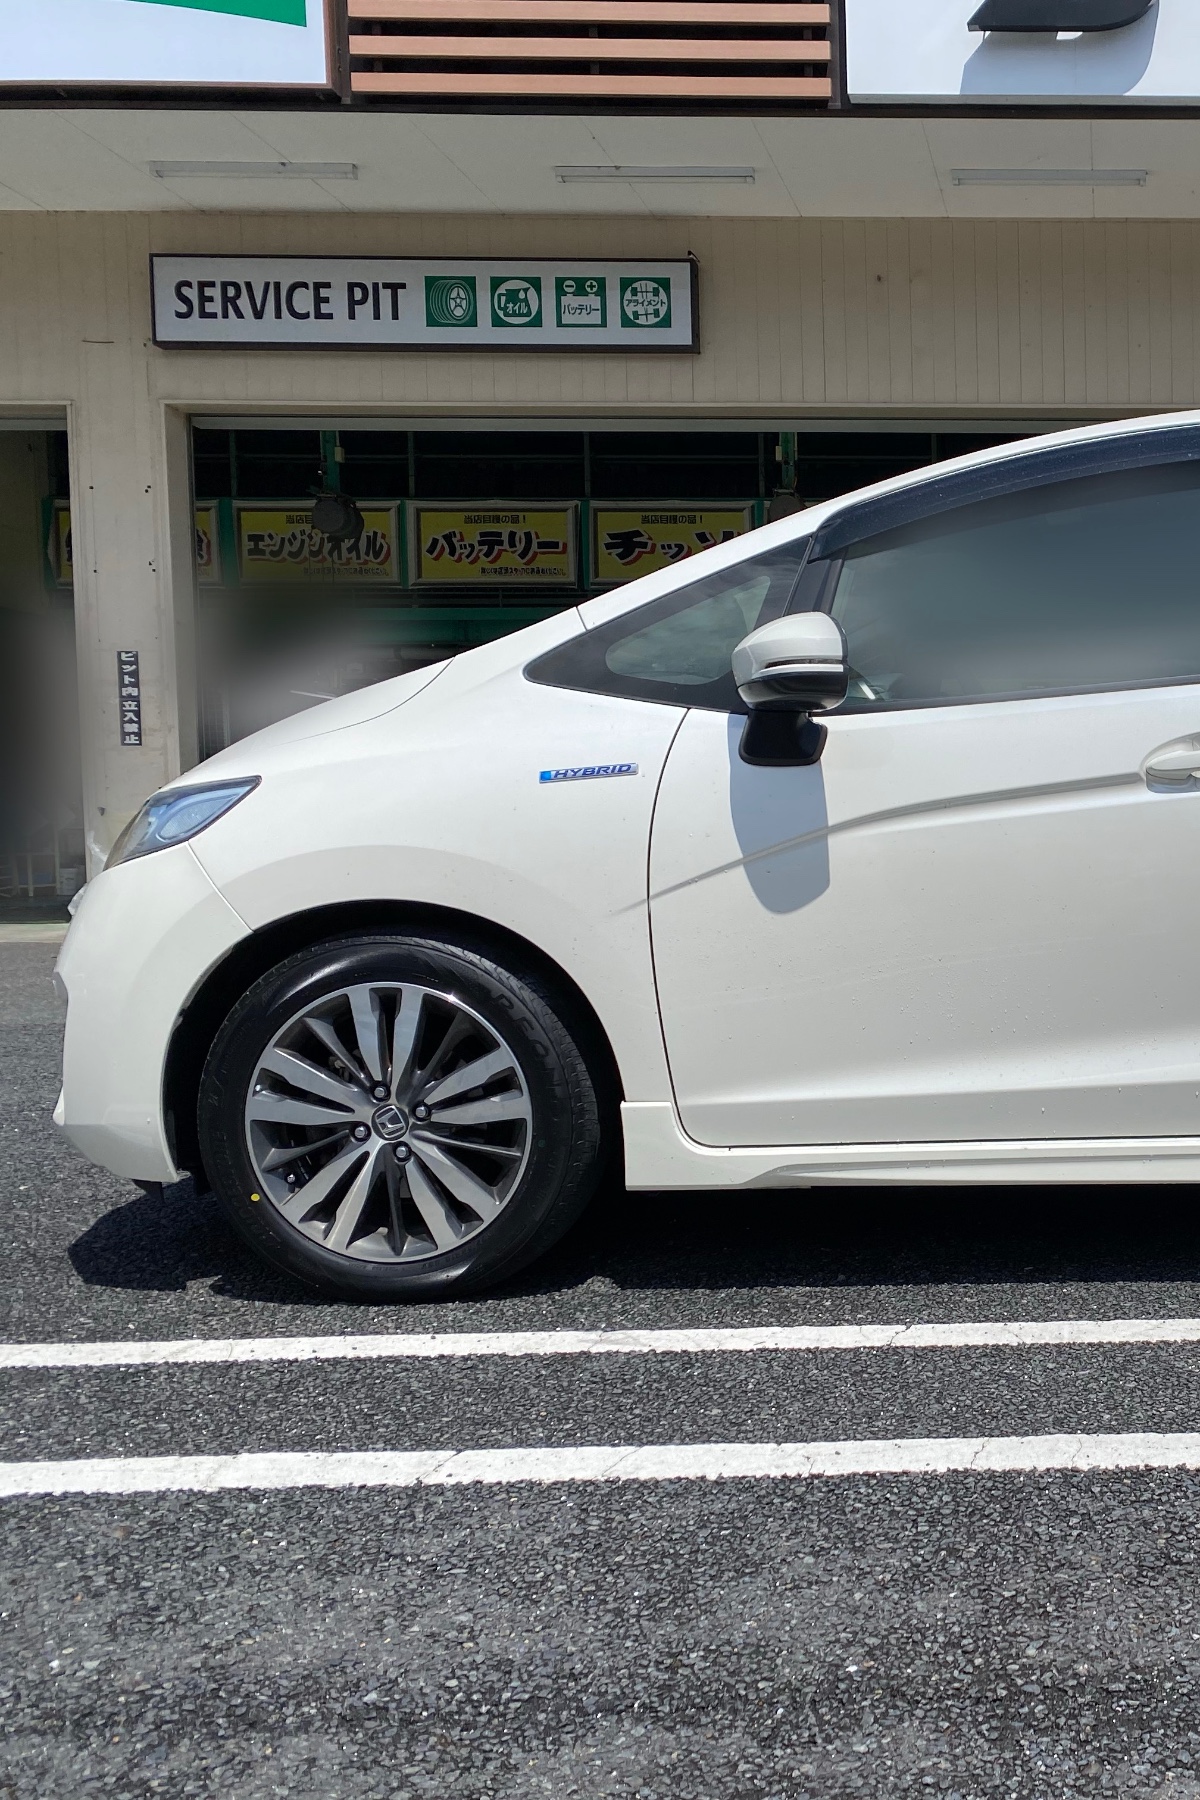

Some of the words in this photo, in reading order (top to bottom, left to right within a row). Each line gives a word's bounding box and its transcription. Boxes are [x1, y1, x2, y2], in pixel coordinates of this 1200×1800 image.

[174, 280, 334, 320] SERVICE
[347, 281, 407, 320] PIT
[506, 302, 528, 314] オイル
[562, 303, 600, 315] バッテリー
[625, 299, 667, 308] アライメント
[246, 528, 389, 563] エンジンオイル
[425, 529, 565, 563] バッテリー
[120, 651, 140, 745] ピット内立入禁止
[553, 764, 633, 779] HYBRID
